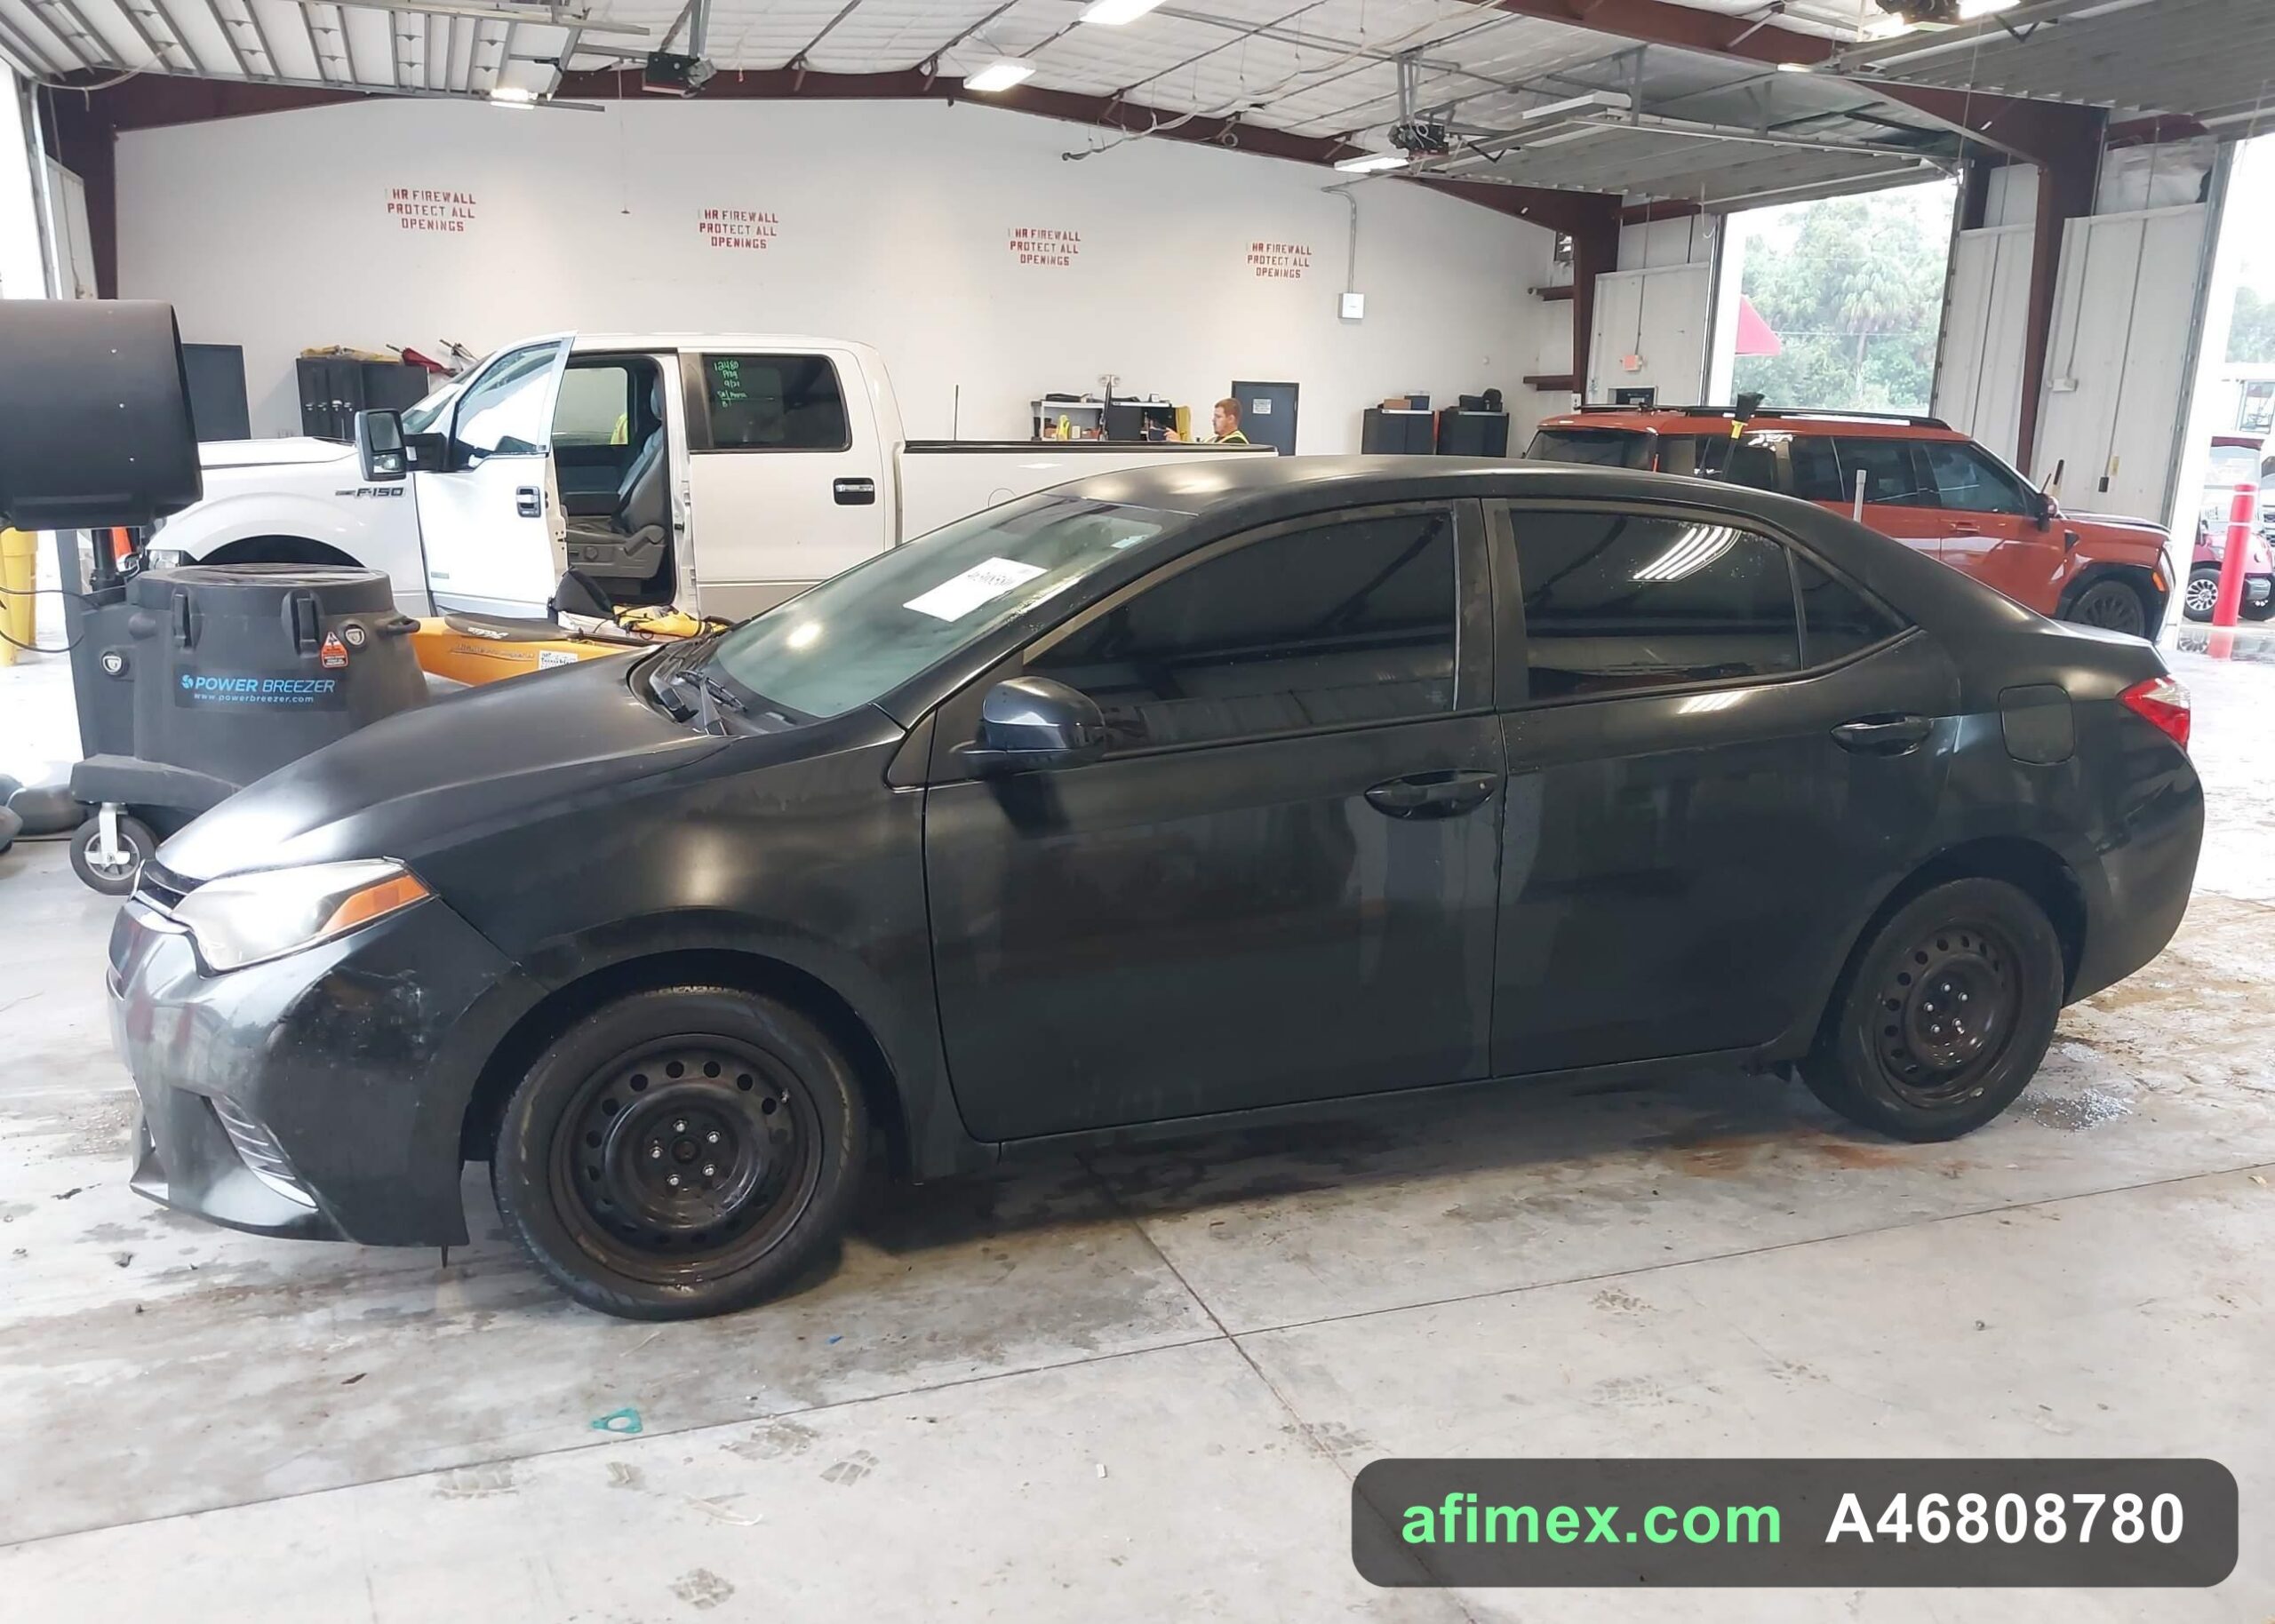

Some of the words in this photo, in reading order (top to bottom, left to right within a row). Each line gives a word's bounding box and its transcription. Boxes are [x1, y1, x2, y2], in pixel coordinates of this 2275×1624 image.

[412, 190, 476, 204] FIREWALL
[387, 203, 445, 217] PROTECT
[451, 206, 475, 219] ALL
[722, 210, 778, 224] FIREWALL
[402, 218, 464, 232] OPENINGS
[699, 222, 751, 235] PROTECT
[756, 226, 777, 236] ALL
[1031, 229, 1081, 242] FIREWALL
[711, 236, 767, 249] OPENINGS
[1010, 241, 1056, 253] PROTECT
[1060, 243, 1079, 254] ALL
[1266, 243, 1312, 256] FIREWALL
[1020, 254, 1070, 266] OPENINGS
[1247, 255, 1289, 266] PROTECT
[1293, 258, 1310, 267] ALL
[1256, 267, 1301, 279] OPENINGS
[356, 487, 404, 498] F-150
[195, 677, 258, 692] POWER
[262, 679, 335, 693] BREEZER
